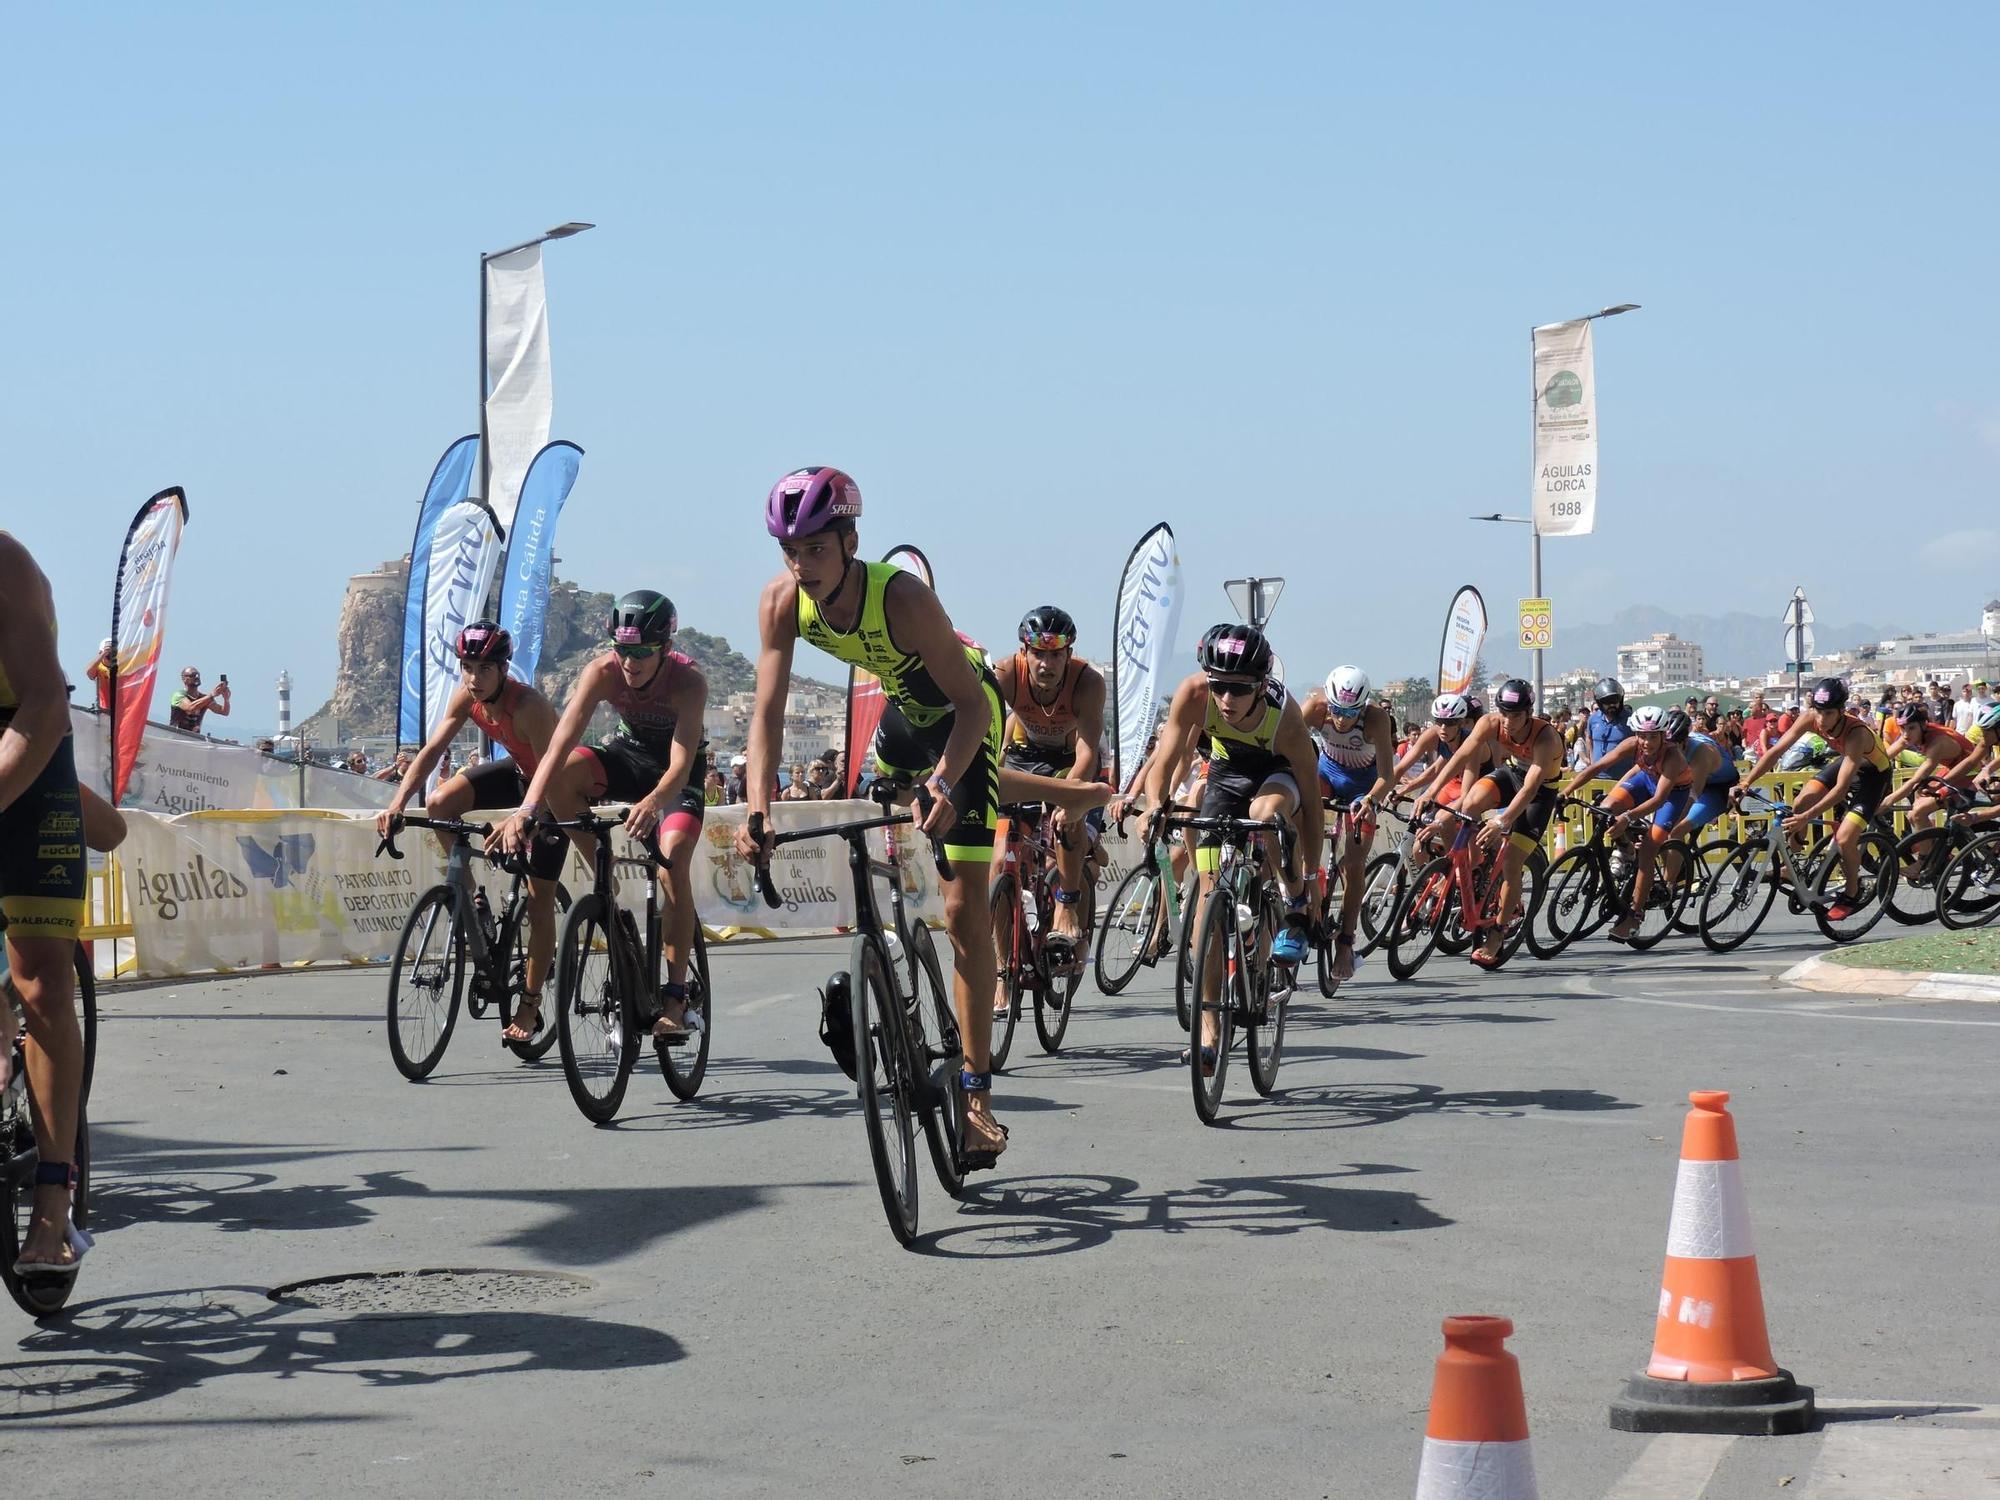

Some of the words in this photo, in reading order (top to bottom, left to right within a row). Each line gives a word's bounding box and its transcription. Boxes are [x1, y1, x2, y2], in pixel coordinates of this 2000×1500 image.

[1541, 463, 1592, 479] ÁGUILAS
[1546, 477, 1586, 492] LORCA
[1549, 501, 1582, 516] 1988
[520, 506, 547, 581] Cálida
[155, 763, 230, 788] Ayuntamiento
[186, 782, 199, 794] de
[50, 846, 80, 855] UCLM
[334, 869, 413, 889] PATRONATO
[790, 863, 803, 879] de
[137, 854, 249, 920] Águilas
[782, 877, 837, 912] guilas
[20, 917, 76, 928] ALBACETE
